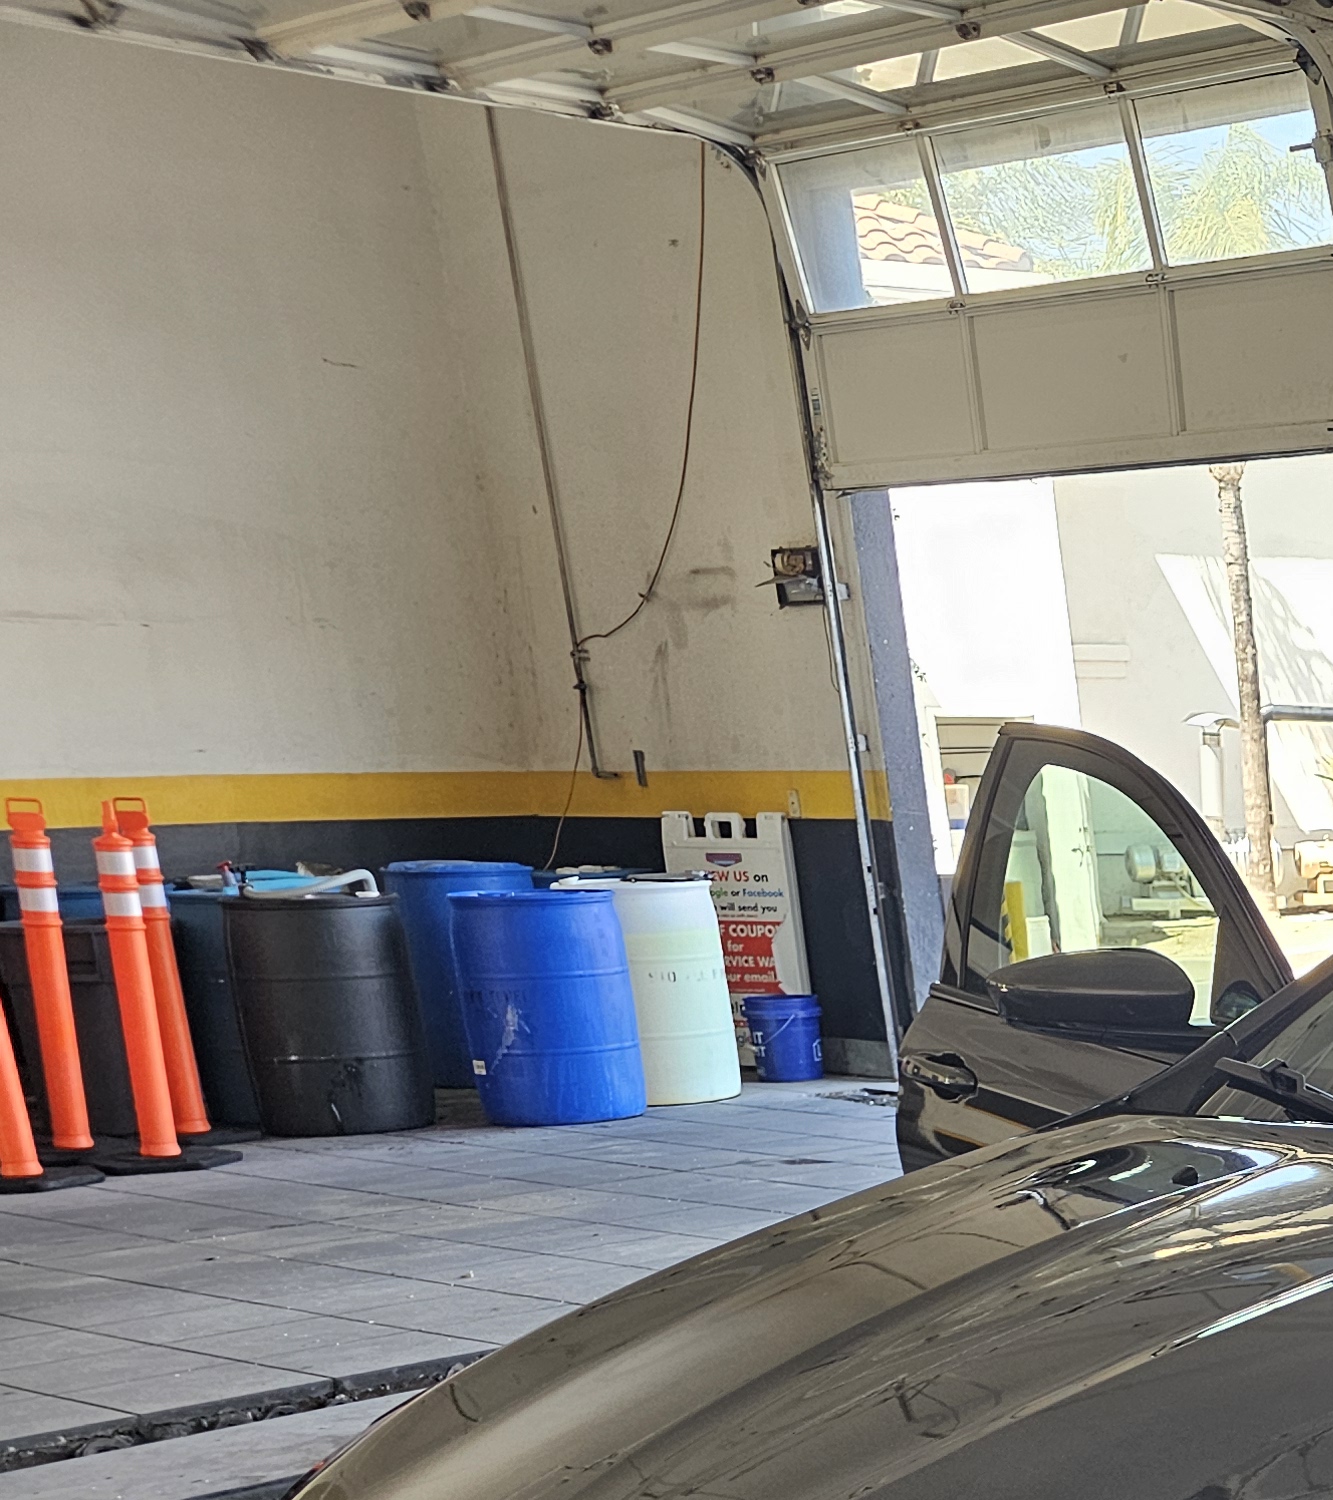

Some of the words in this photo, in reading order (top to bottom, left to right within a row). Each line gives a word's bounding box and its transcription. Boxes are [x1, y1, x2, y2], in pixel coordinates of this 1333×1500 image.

[733, 870, 750, 882] US
[753, 874, 769, 882] on
[742, 888, 784, 897] Facebook
[720, 902, 735, 911] will
[738, 902, 759, 911] send
[761, 906, 778, 914] you
[727, 940, 744, 952] for
[724, 956, 755, 967] RVICE
[757, 956, 776, 967] WA
